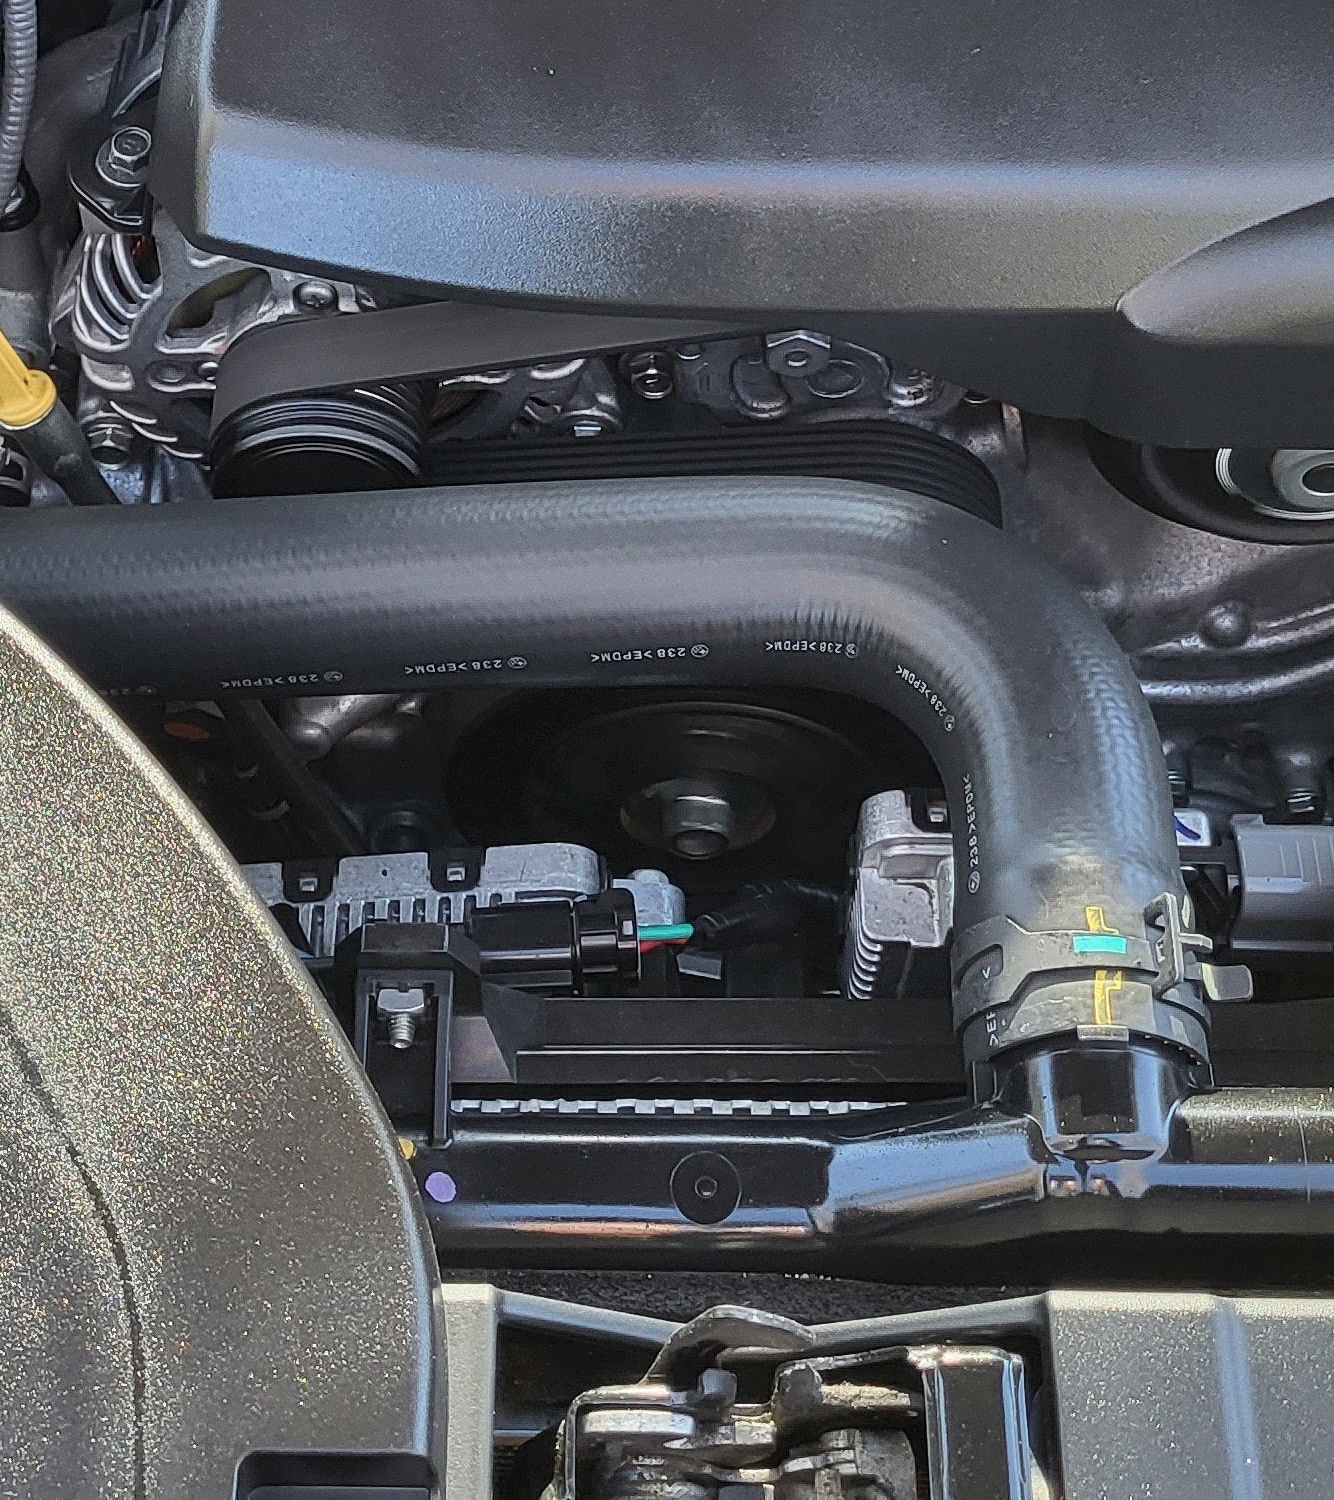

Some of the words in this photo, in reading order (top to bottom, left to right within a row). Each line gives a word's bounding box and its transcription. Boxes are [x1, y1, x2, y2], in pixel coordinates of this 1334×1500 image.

[657, 647, 687, 659] 238
[472, 658, 503, 671] 238
[968, 835, 979, 868] 238
